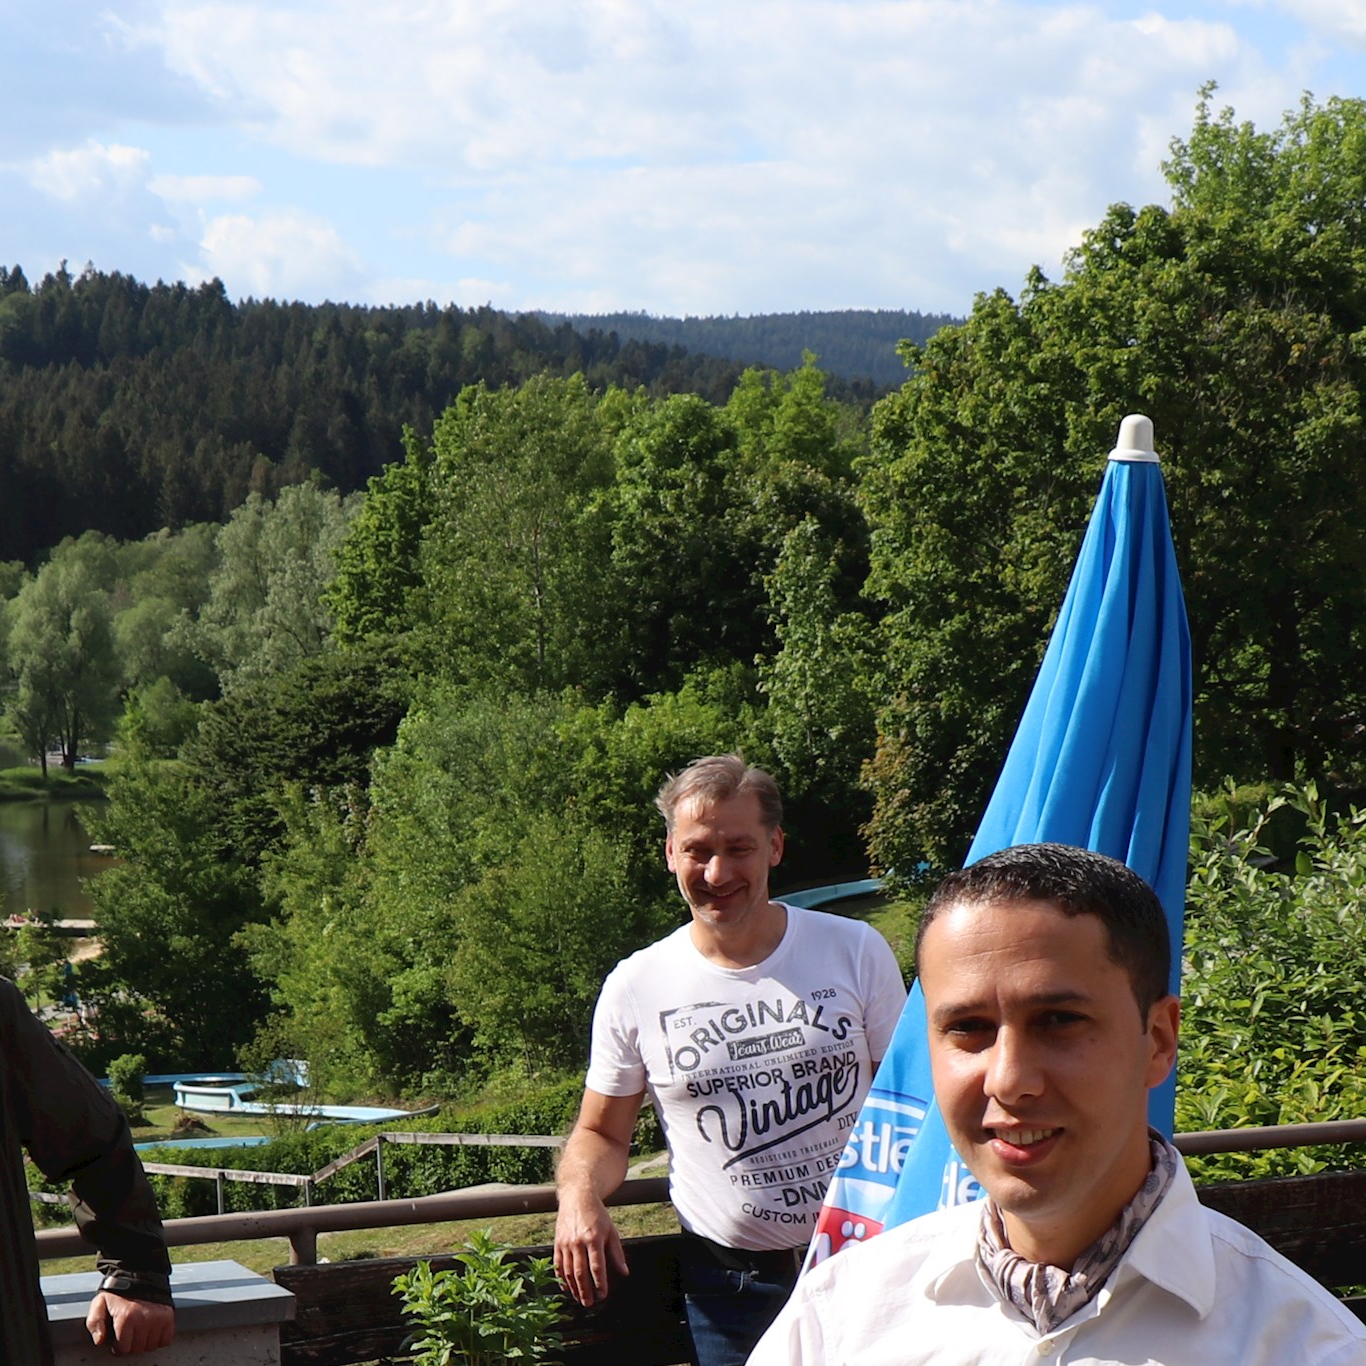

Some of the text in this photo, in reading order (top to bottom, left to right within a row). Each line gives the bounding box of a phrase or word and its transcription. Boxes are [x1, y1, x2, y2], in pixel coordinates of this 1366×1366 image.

[810, 988, 837, 1002] 1928
[673, 1015, 697, 1030] EST.
[674, 998, 852, 1072] ORIGINALS
[681, 1039, 855, 1081] INTERNATIONAL UNLIMITED EDITION
[686, 1050, 857, 1099] SUPERIOR BRAND
[696, 1062, 861, 1155] Vintage
[729, 1151, 843, 1187] PREMIUM DES
[749, 1137, 840, 1165] REGISTERED TRADEMARK
[741, 1202, 807, 1225] CUSTOM
